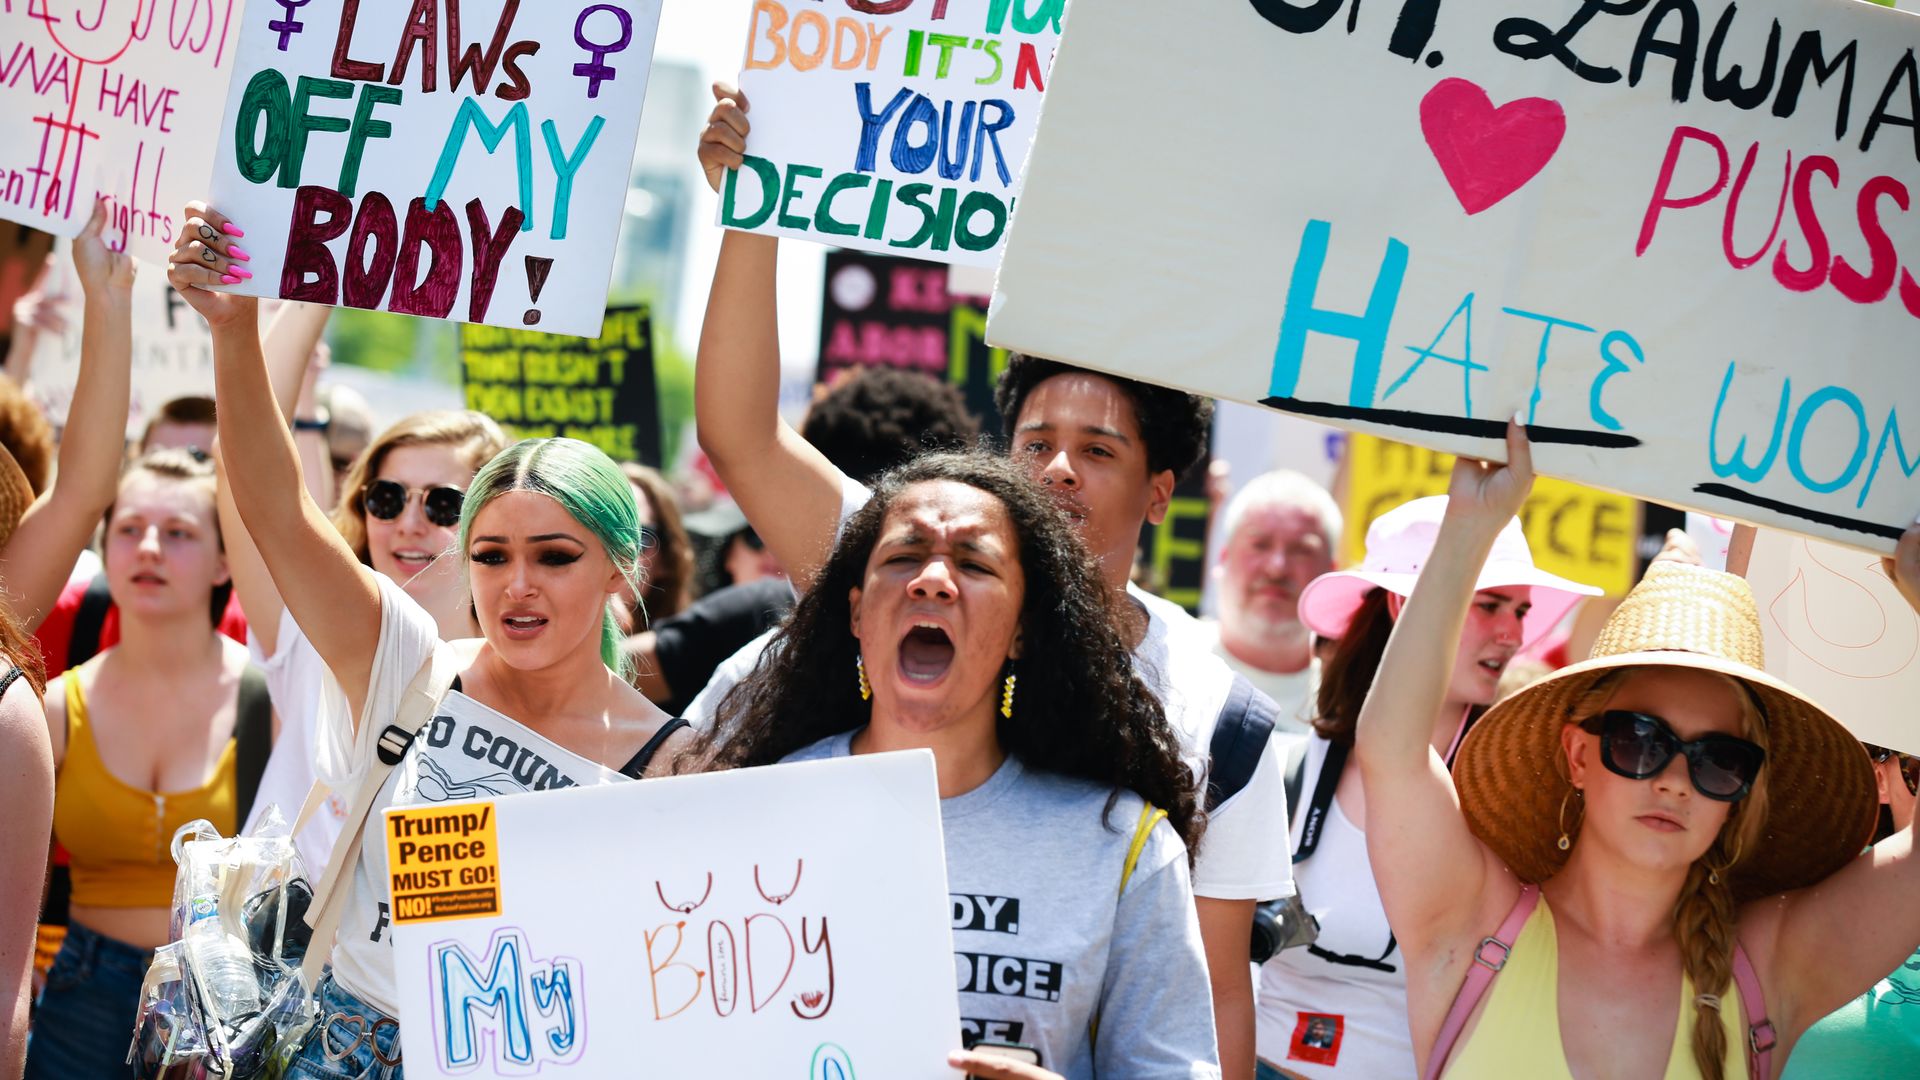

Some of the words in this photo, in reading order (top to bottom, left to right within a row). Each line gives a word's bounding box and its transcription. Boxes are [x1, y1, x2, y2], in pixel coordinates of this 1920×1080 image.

[745, 0, 893, 72] BODY
[903, 29, 1002, 85] IT'S
[98, 68, 180, 133] HAVE
[854, 82, 1016, 187] YOUR
[235, 68, 402, 198] OFF
[424, 95, 606, 240] MY
[95, 140, 173, 254] rights
[721, 153, 1016, 252] DECISIO
[1635, 125, 1920, 319] PUSS
[279, 185, 554, 325] BODY!
[828, 321, 947, 370] ABOR
[1268, 218, 1645, 431] HATE
[462, 725, 582, 791] COUN
[389, 806, 490, 838] Trump/
[399, 840, 486, 865] Pence
[392, 869, 453, 892] MUST
[459, 865, 496, 886] GO!
[397, 896, 433, 918] NO!
[949, 895, 1018, 933] DY.
[436, 933, 576, 1069] My
[644, 912, 835, 1020] BODY
